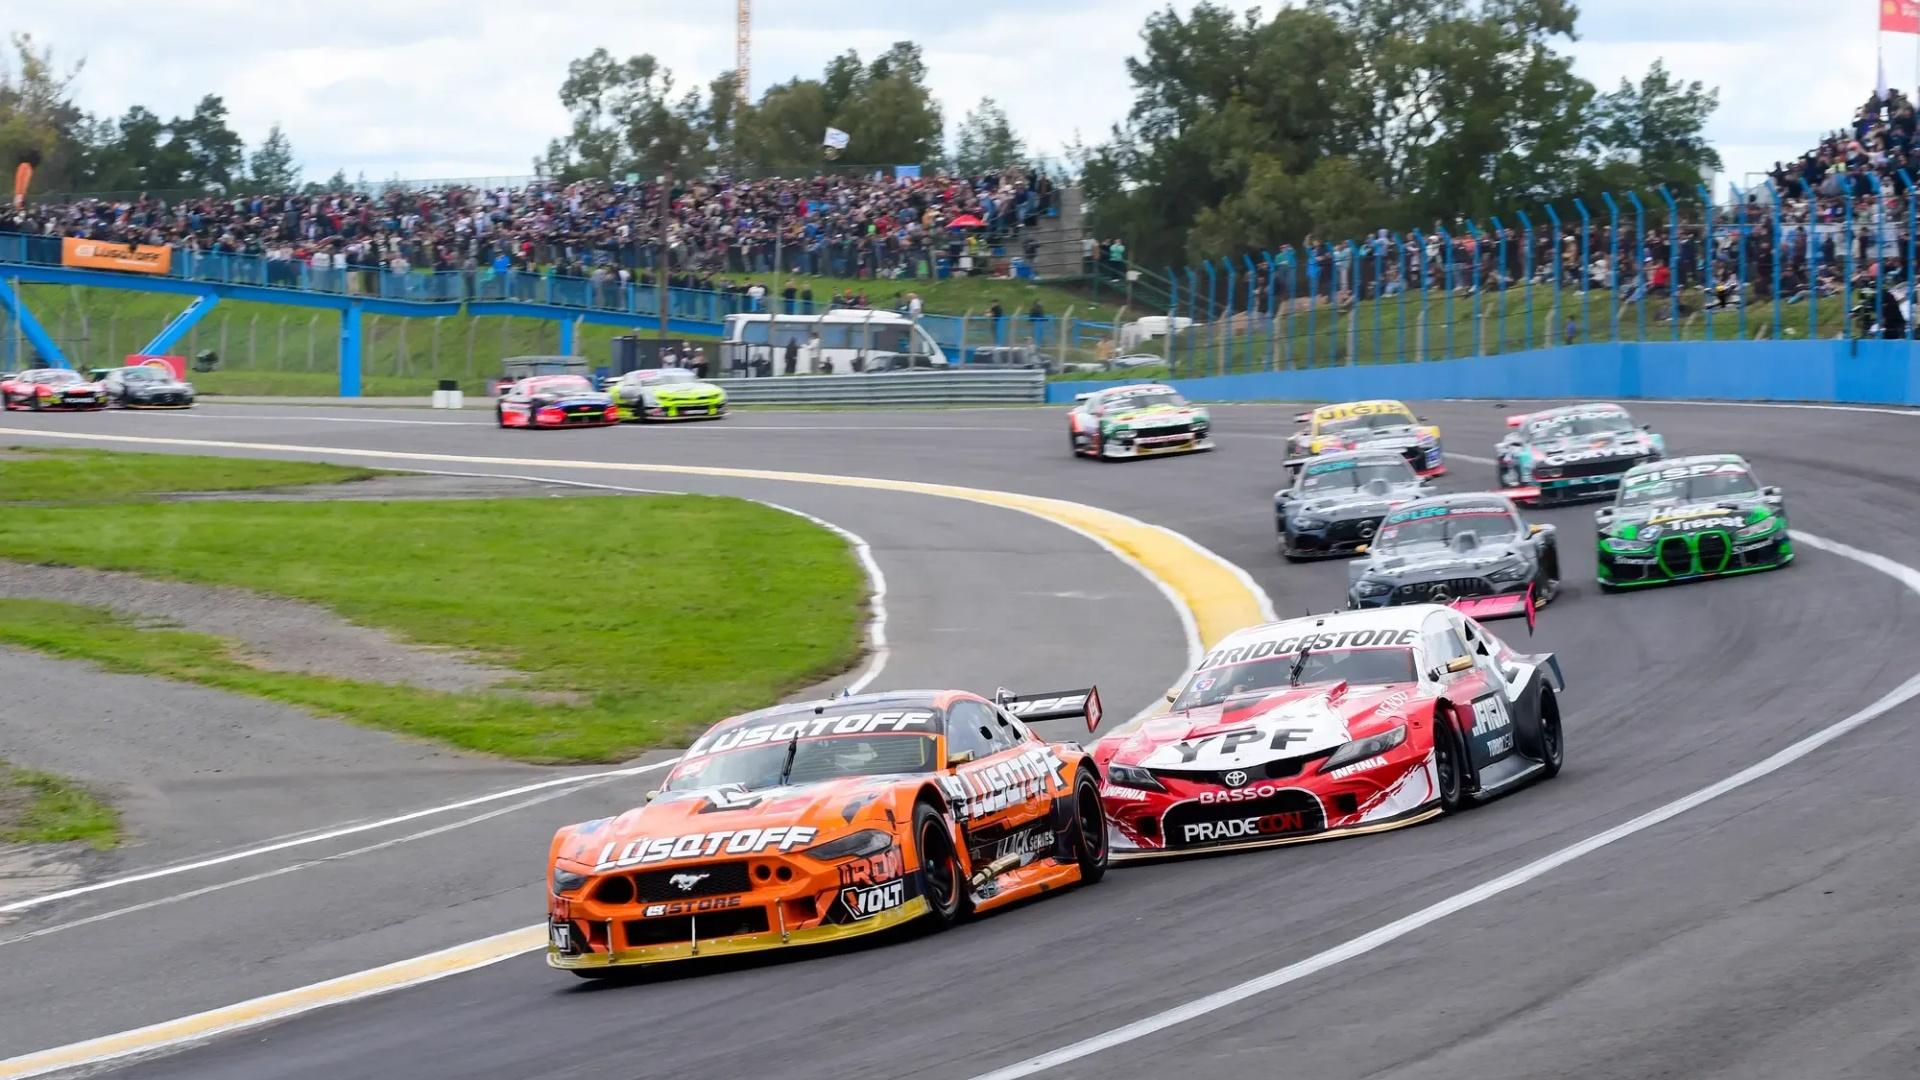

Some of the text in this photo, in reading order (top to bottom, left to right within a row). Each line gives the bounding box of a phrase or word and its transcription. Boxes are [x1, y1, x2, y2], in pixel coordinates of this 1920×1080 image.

[1625, 464, 1748, 487] FISPA
[1199, 629, 1419, 670] BRIDGESTONE
[1173, 728, 1313, 763] YPF
[1331, 755, 1388, 780] INFINIA
[1200, 785, 1276, 804] BASSO
[665, 896, 742, 914] STORE
[846, 883, 902, 916] VOLT
